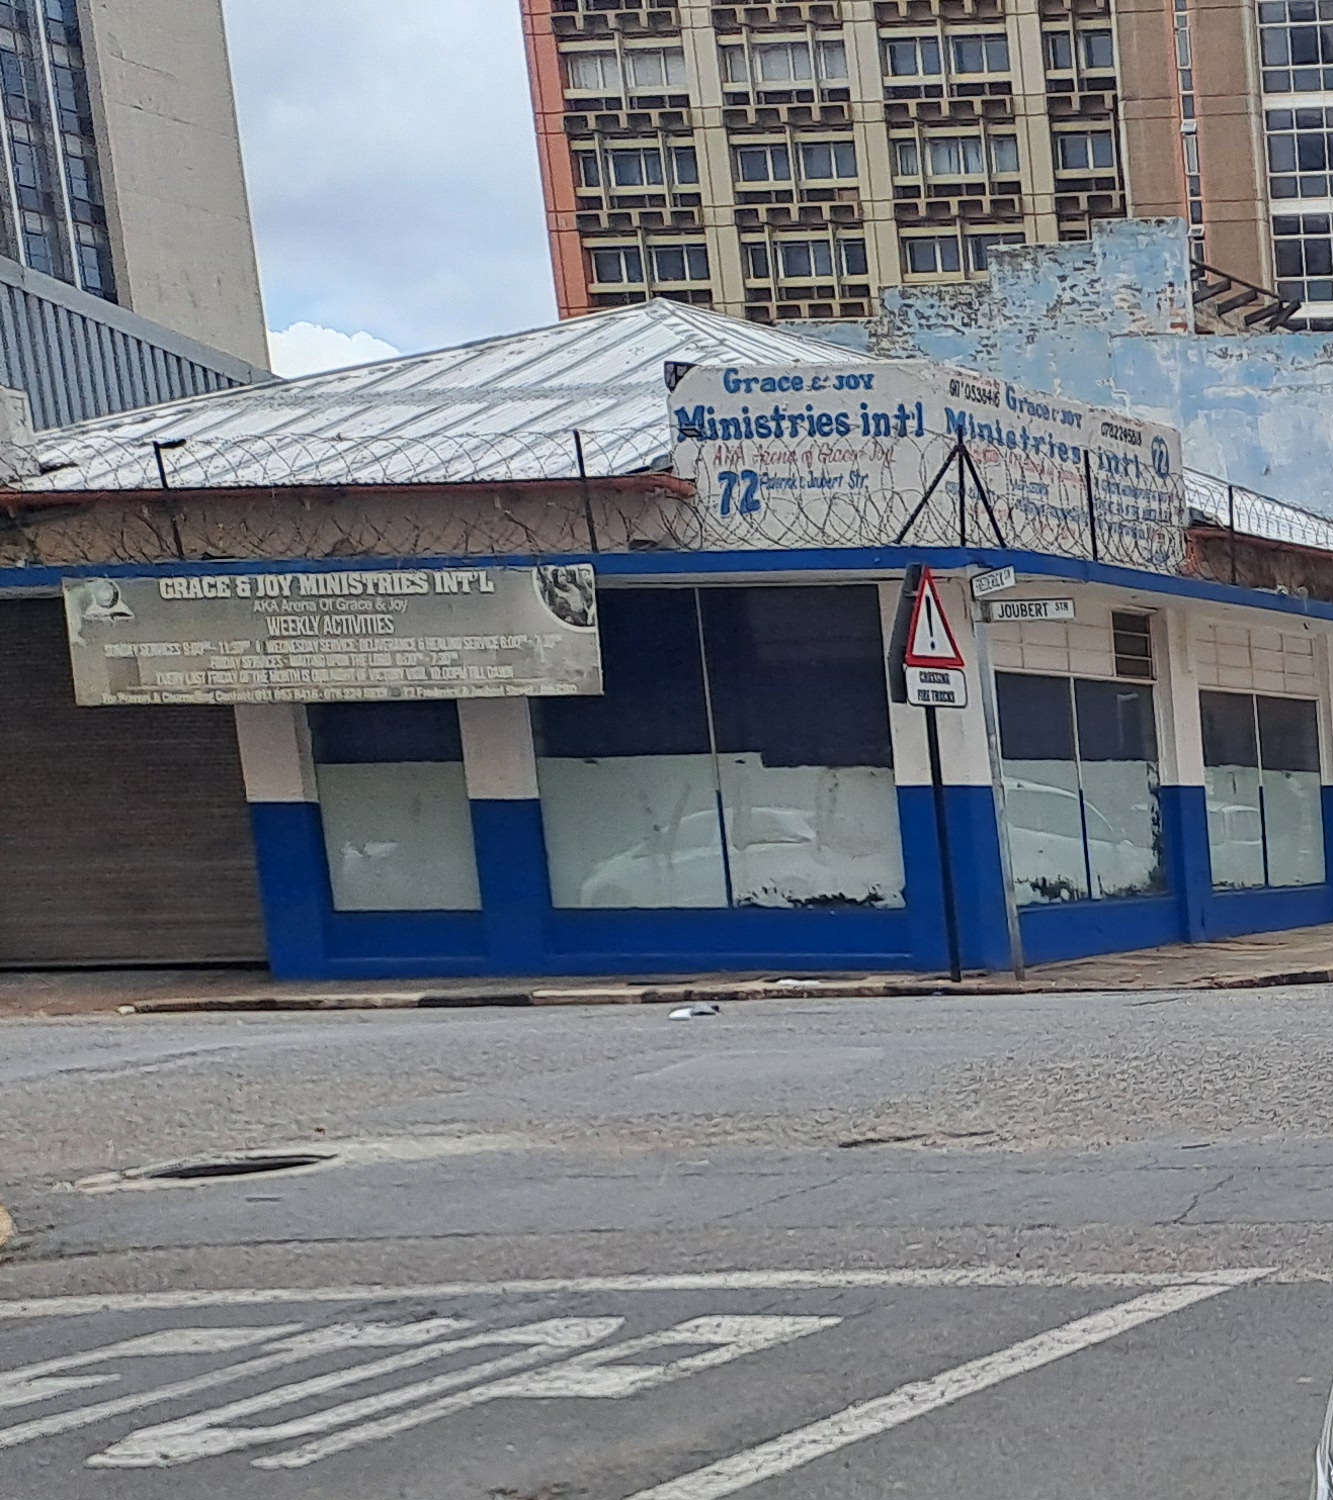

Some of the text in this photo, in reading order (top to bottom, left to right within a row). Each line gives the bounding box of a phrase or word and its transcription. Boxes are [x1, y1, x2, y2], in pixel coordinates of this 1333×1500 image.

[723, 368, 804, 394] Grace
[1005, 385, 1049, 421] Grace
[674, 403, 850, 442] Ministries
[944, 405, 1082, 465] Ministries
[718, 470, 762, 518] 72
[159, 569, 495, 600] GRACE & JOY MINISTRIES INT'L
[253, 600, 279, 613] AKA
[336, 598, 373, 611] Grace
[375, 598, 387, 610] &
[388, 598, 409, 614] Joy
[998, 602, 1049, 619] JOUBERT
[265, 613, 396, 637] WEEKLY ACTIVITIES
